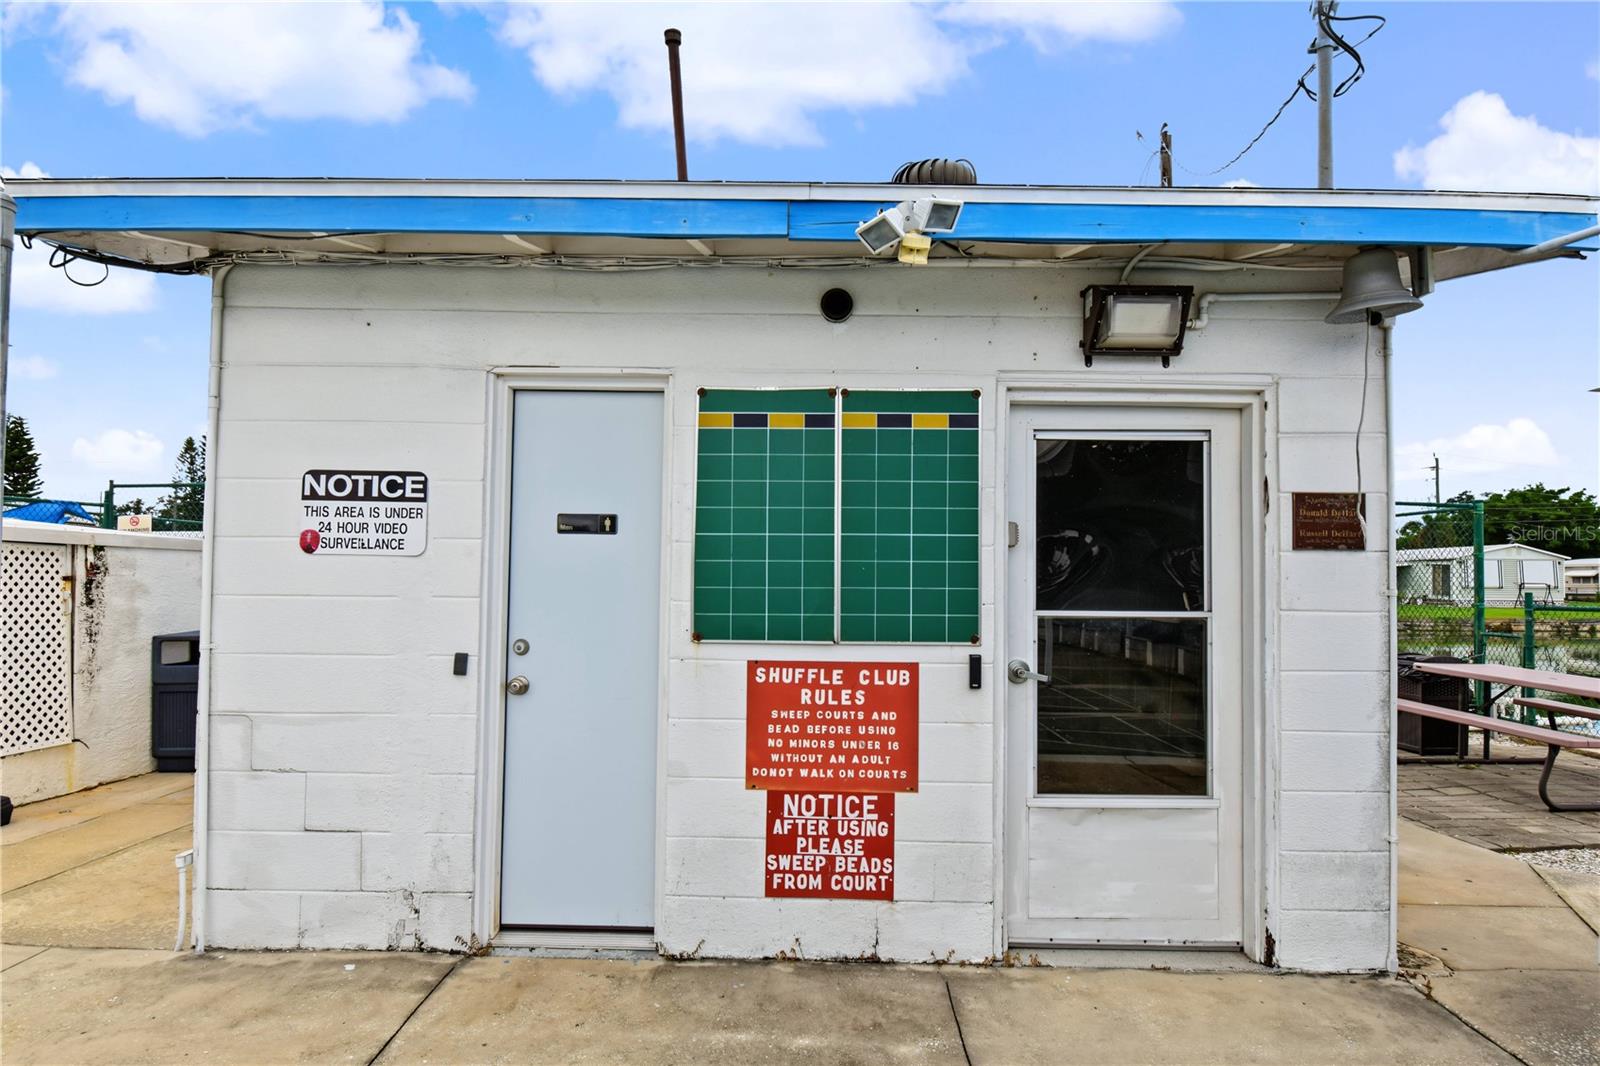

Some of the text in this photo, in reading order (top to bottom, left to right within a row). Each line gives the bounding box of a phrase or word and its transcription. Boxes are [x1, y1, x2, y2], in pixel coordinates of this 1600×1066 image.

[303, 474, 425, 498] NOTICE
[304, 505, 424, 519] THIS AREA IS UNDER
[318, 521, 408, 535] 24 HOUR VIDEO
[320, 537, 405, 550] SURVEILLANCE
[755, 667, 910, 686] SHUFFLE CLUB
[800, 688, 866, 705] RULES
[771, 710, 897, 720] SWEEP COURTS AND
[767, 724, 896, 735] BEAD BEFORE USING
[767, 739, 900, 750] NO MINORS UNDER 16
[771, 753, 891, 765] WITHOUT AN ADULT
[799, 768, 834, 778] WALK
[838, 770, 855, 778] ON
[858, 770, 908, 779] COURTS
[783, 794, 879, 820] NOTICE
[772, 819, 889, 837] AFTER USING
[796, 837, 865, 856] PLEASE
[766, 854, 893, 874] SWEEP BEADS
[772, 873, 889, 892] FROM COURT
